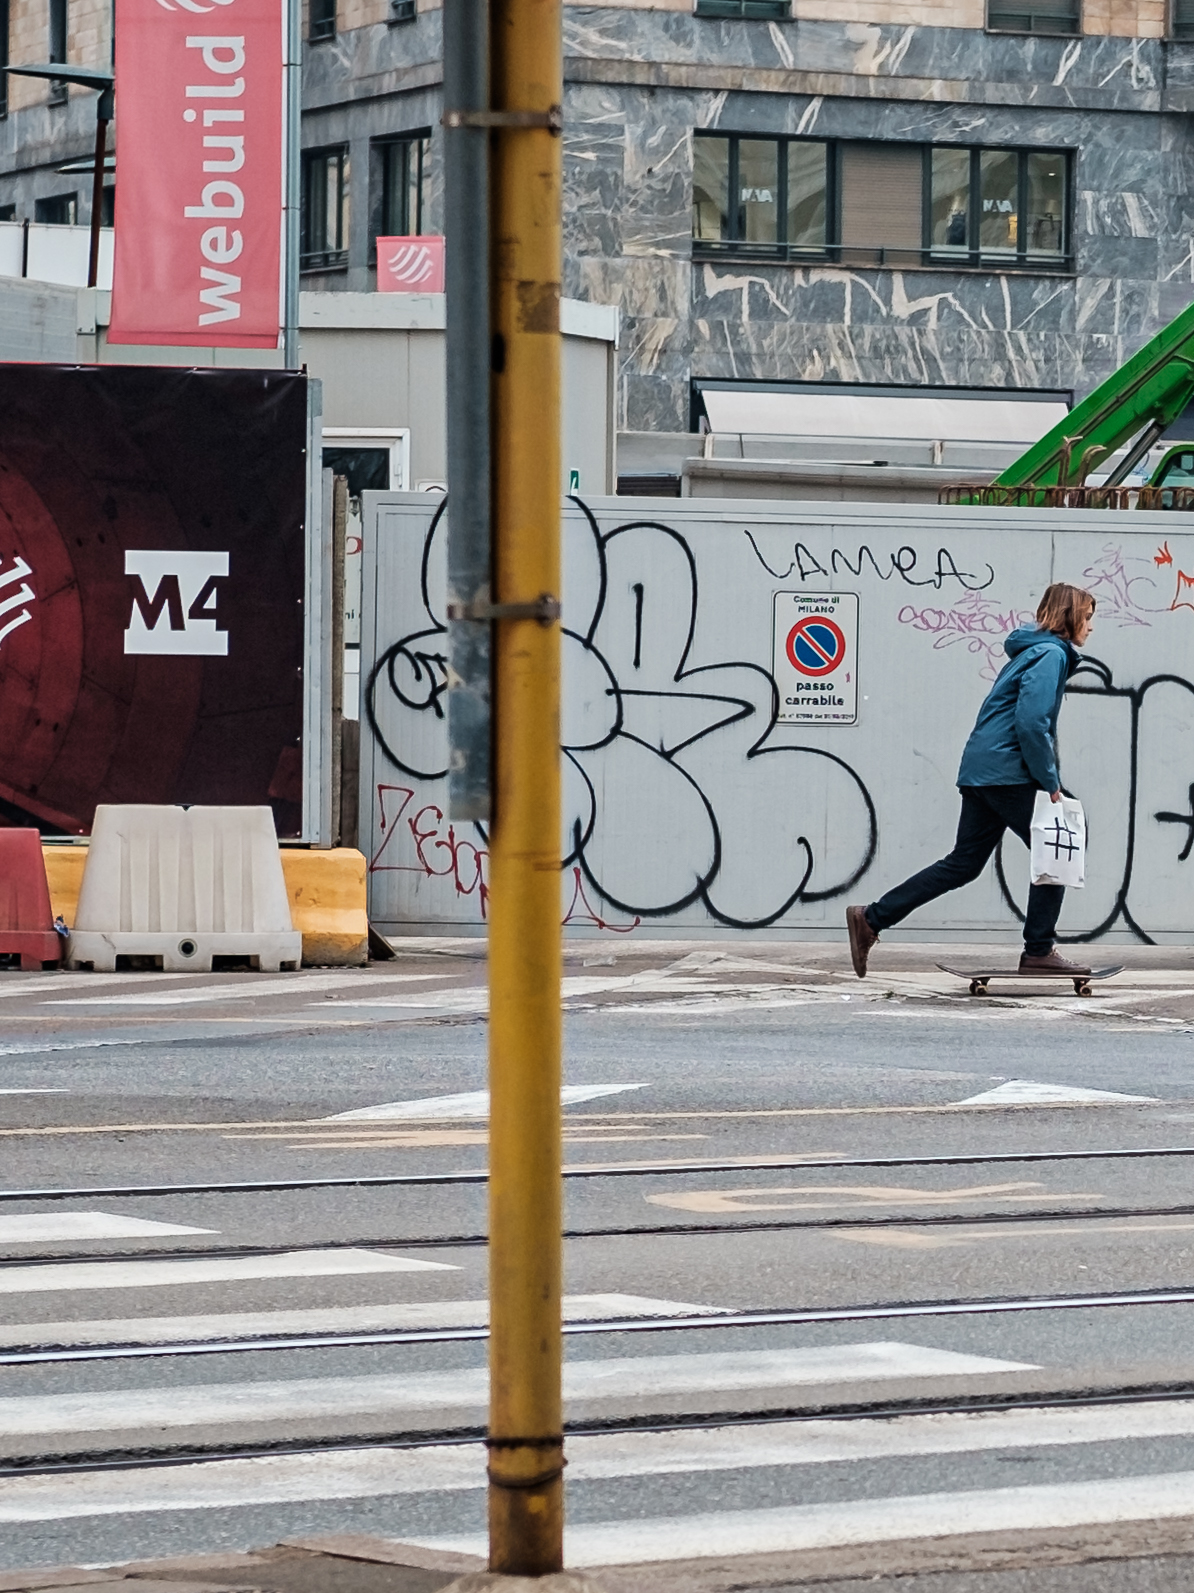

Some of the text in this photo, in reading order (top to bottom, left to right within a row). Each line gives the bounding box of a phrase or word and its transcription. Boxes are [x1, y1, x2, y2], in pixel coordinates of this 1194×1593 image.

[182, 35, 246, 326] webuild
[793, 595, 840, 604] Comune di
[797, 605, 835, 613] MILANO
[796, 682, 835, 692] passo
[785, 695, 845, 706] carrabile
